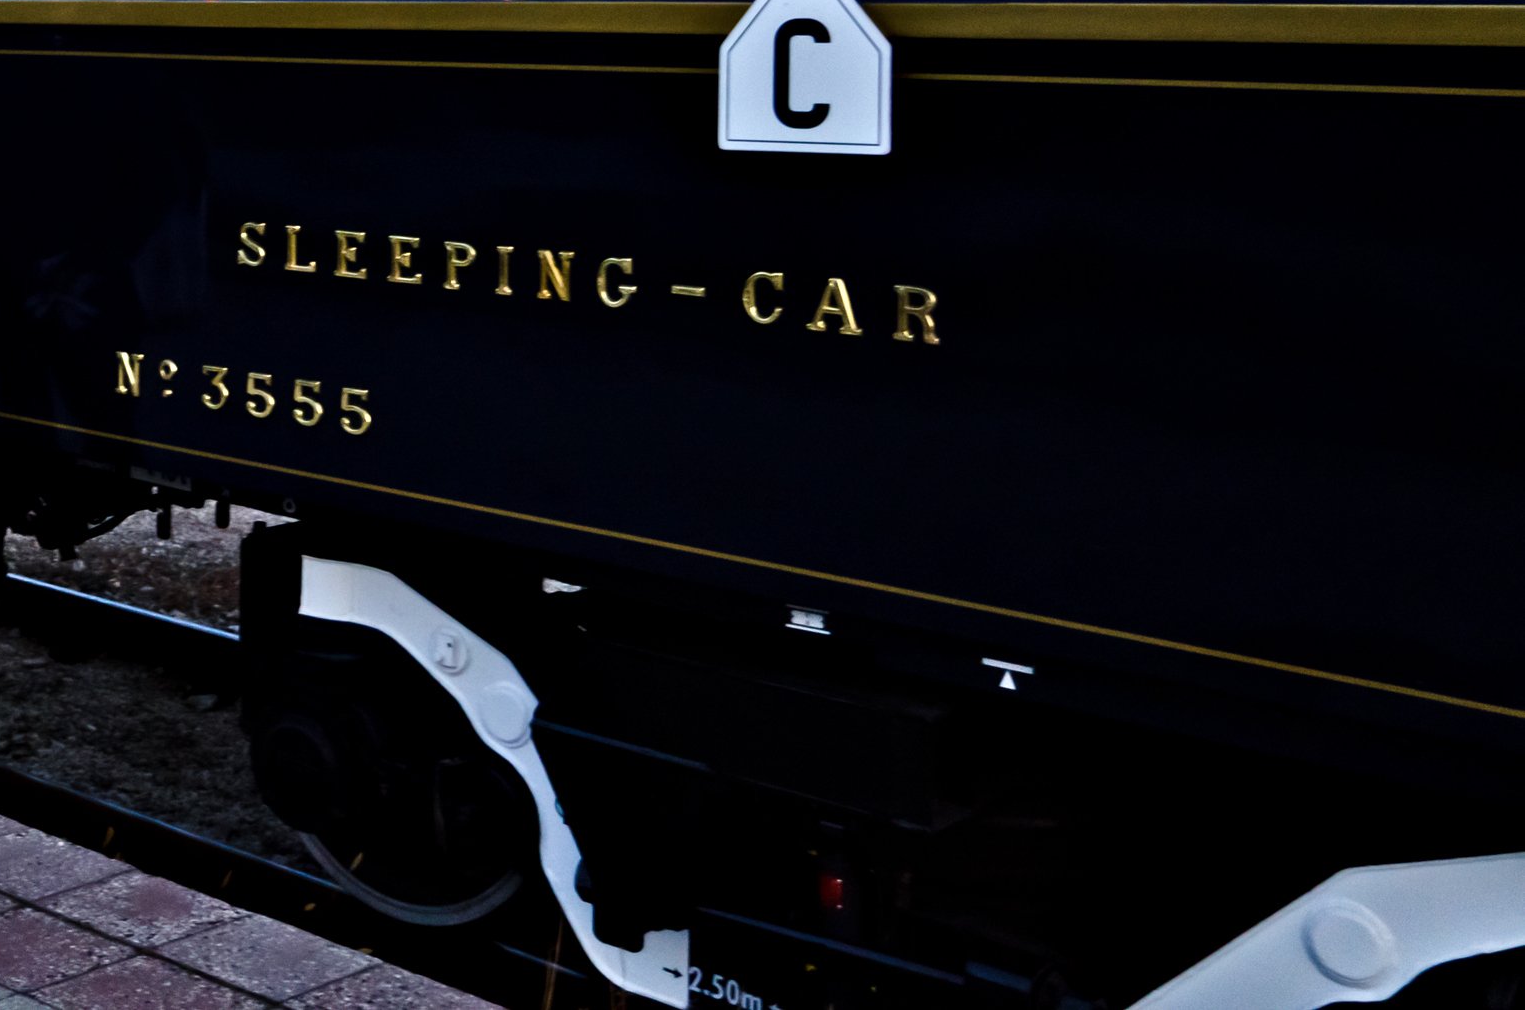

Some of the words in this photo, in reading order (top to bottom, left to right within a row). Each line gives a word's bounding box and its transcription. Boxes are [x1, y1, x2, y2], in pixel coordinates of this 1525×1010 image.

[773, 18, 831, 129] C
[237, 222, 638, 308] SLEEPING
[741, 271, 941, 345] CAR
[201, 365, 372, 435] 3555
